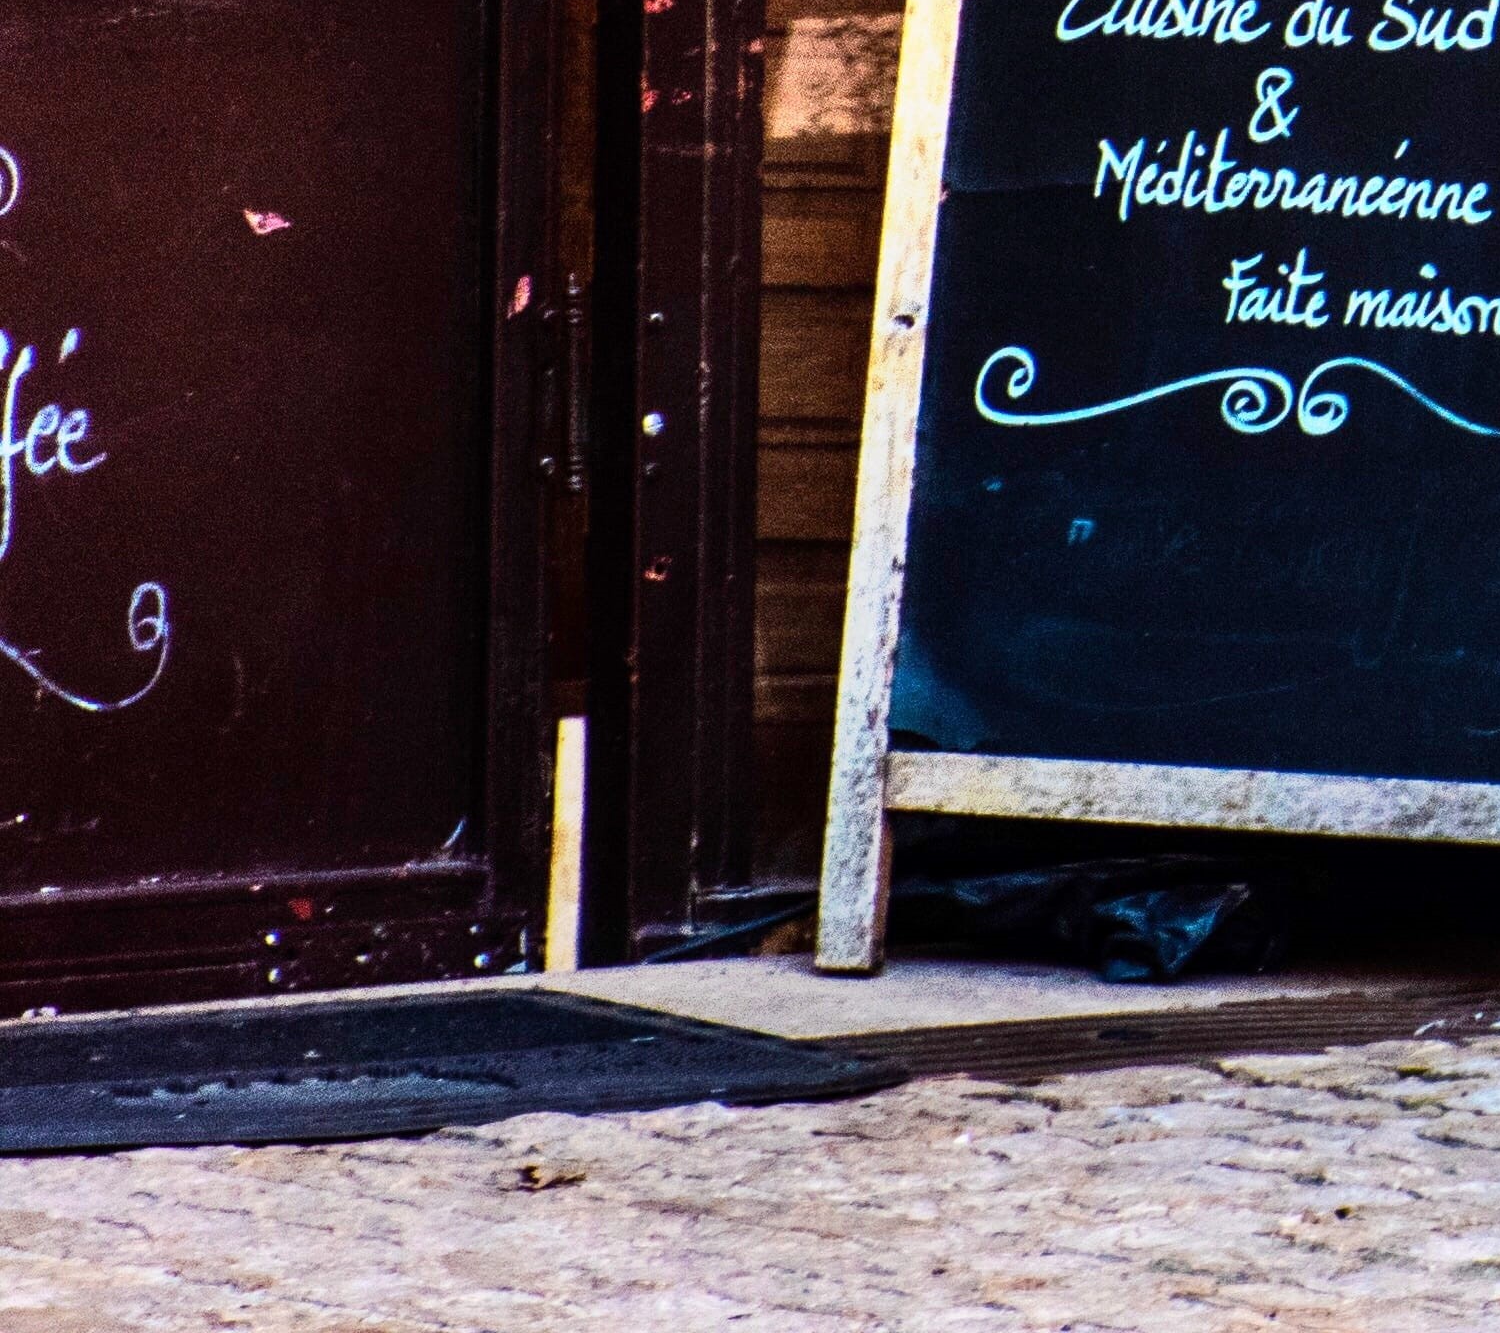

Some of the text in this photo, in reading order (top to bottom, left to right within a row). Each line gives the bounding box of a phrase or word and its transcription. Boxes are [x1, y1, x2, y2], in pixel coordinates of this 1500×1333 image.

[1248, 67, 1300, 143] &
[1222, 247, 1329, 328] Faite
[0, 328, 107, 560] fée
